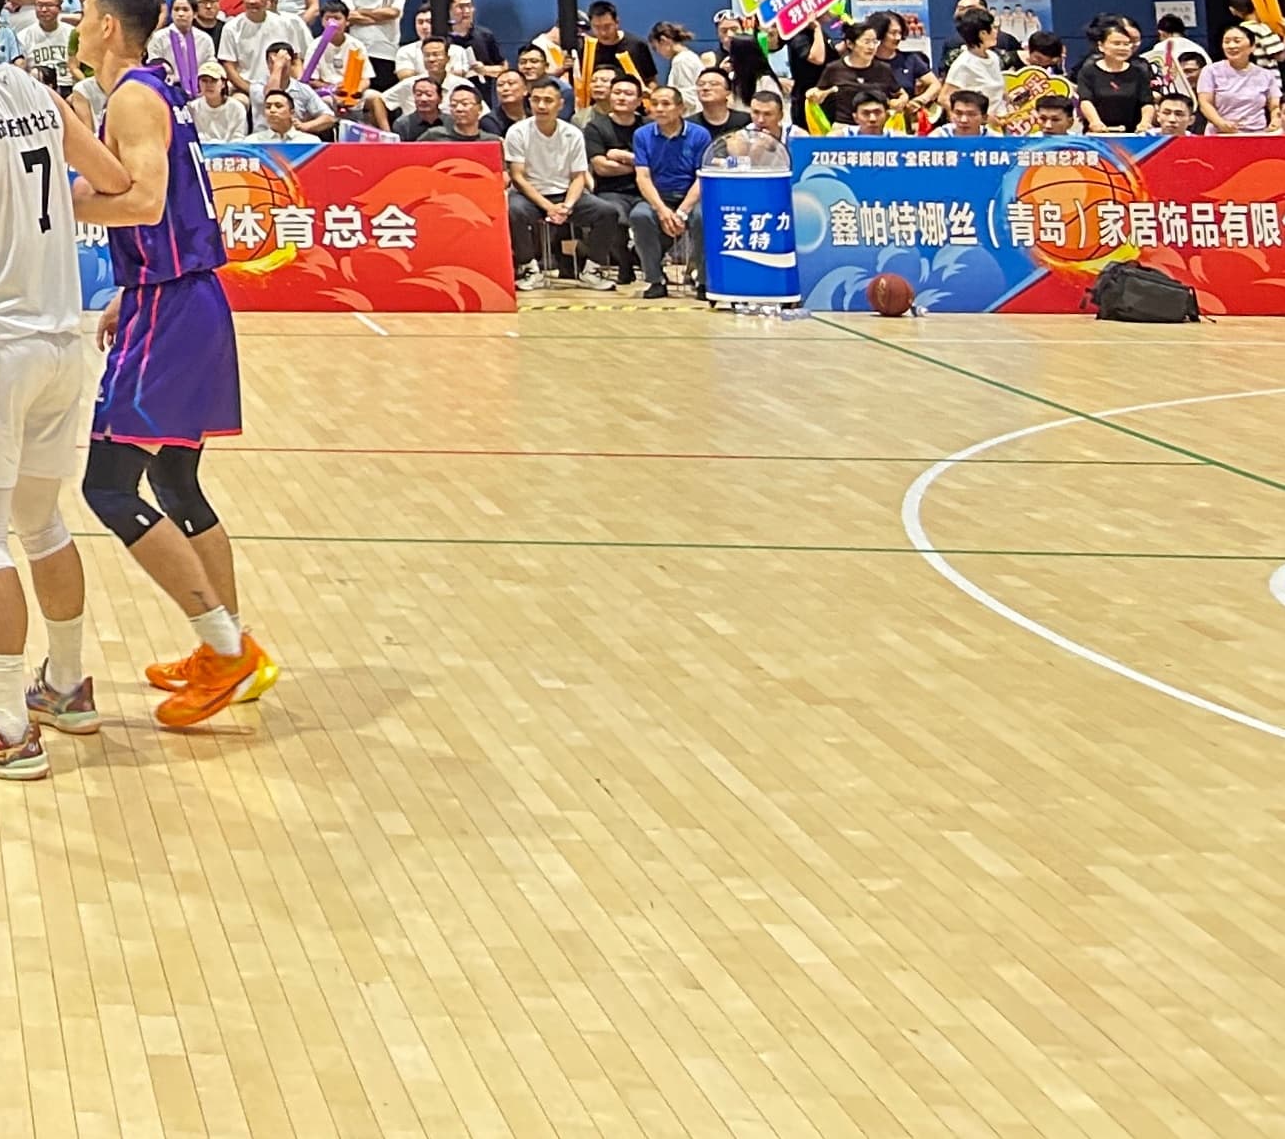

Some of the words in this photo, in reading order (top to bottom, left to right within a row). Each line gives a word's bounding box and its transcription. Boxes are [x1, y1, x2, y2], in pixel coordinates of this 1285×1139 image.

[21, 146, 51, 234] 7
[220, 204, 418, 251] 体育总会
[721, 211, 790, 232] 宝矿力
[723, 231, 771, 250] 水特
[830, 199, 1285, 248] 鑫帕特娜丝（青岛）家居饰品有限
